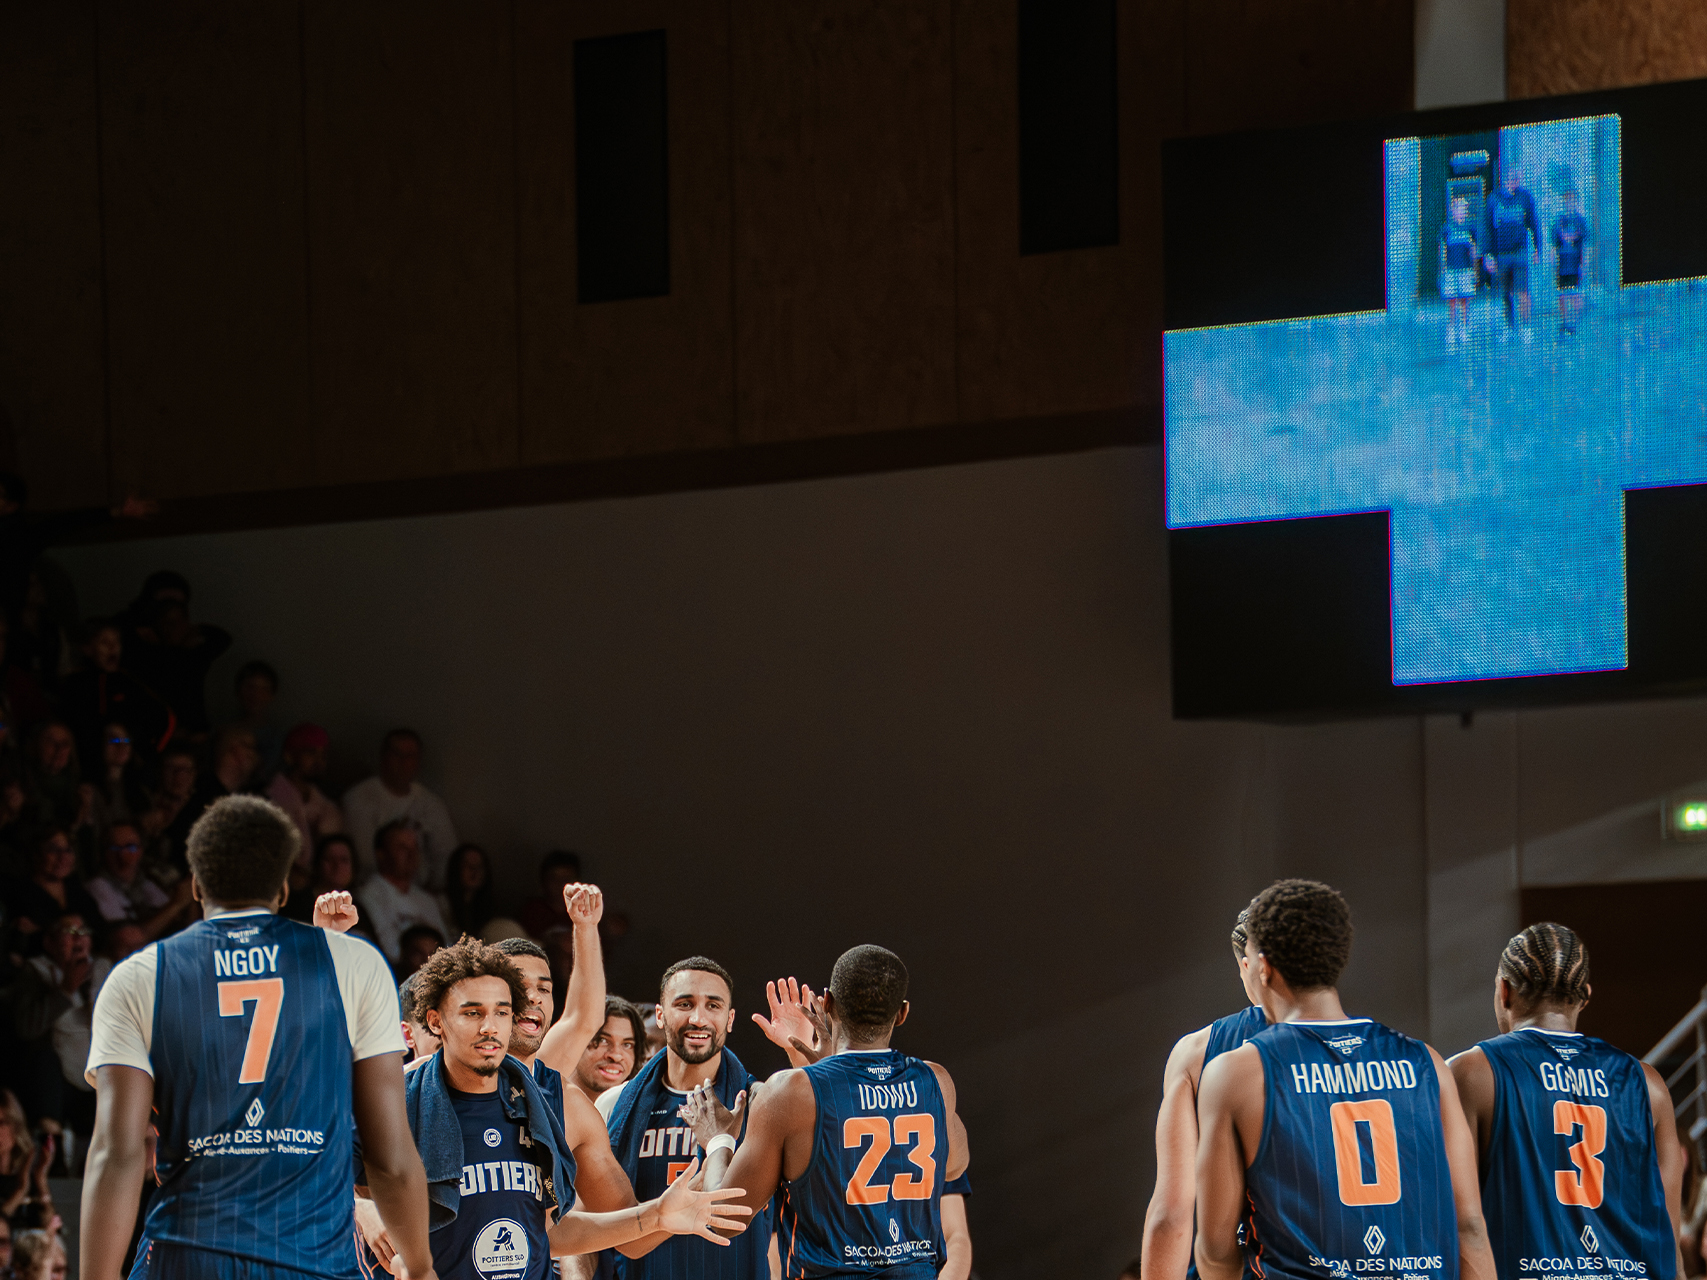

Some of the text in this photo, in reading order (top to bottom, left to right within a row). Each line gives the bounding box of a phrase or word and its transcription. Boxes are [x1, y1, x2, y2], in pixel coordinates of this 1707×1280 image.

[213, 944, 280, 977] NGOY
[217, 977, 284, 1084] 7
[1291, 1059, 1417, 1094] HAMMOND
[1539, 1061, 1610, 1098] GOMIS
[858, 1080, 918, 1110] IDOWU
[234, 1129, 263, 1144] DES
[266, 1128, 324, 1145] NATIONS
[1330, 1098, 1402, 1207] 0
[843, 1113, 937, 1206] 23
[1553, 1100, 1608, 1210] 3
[459, 1160, 544, 1202] OITIERS
[481, 1254, 514, 1264] POITIERS
[884, 1244, 904, 1257] DES
[1355, 1258, 1386, 1272] DES
[1389, 1255, 1443, 1271] NATIONS
[1519, 1257, 1574, 1272] SACOA
[1576, 1256, 1604, 1270] DES
